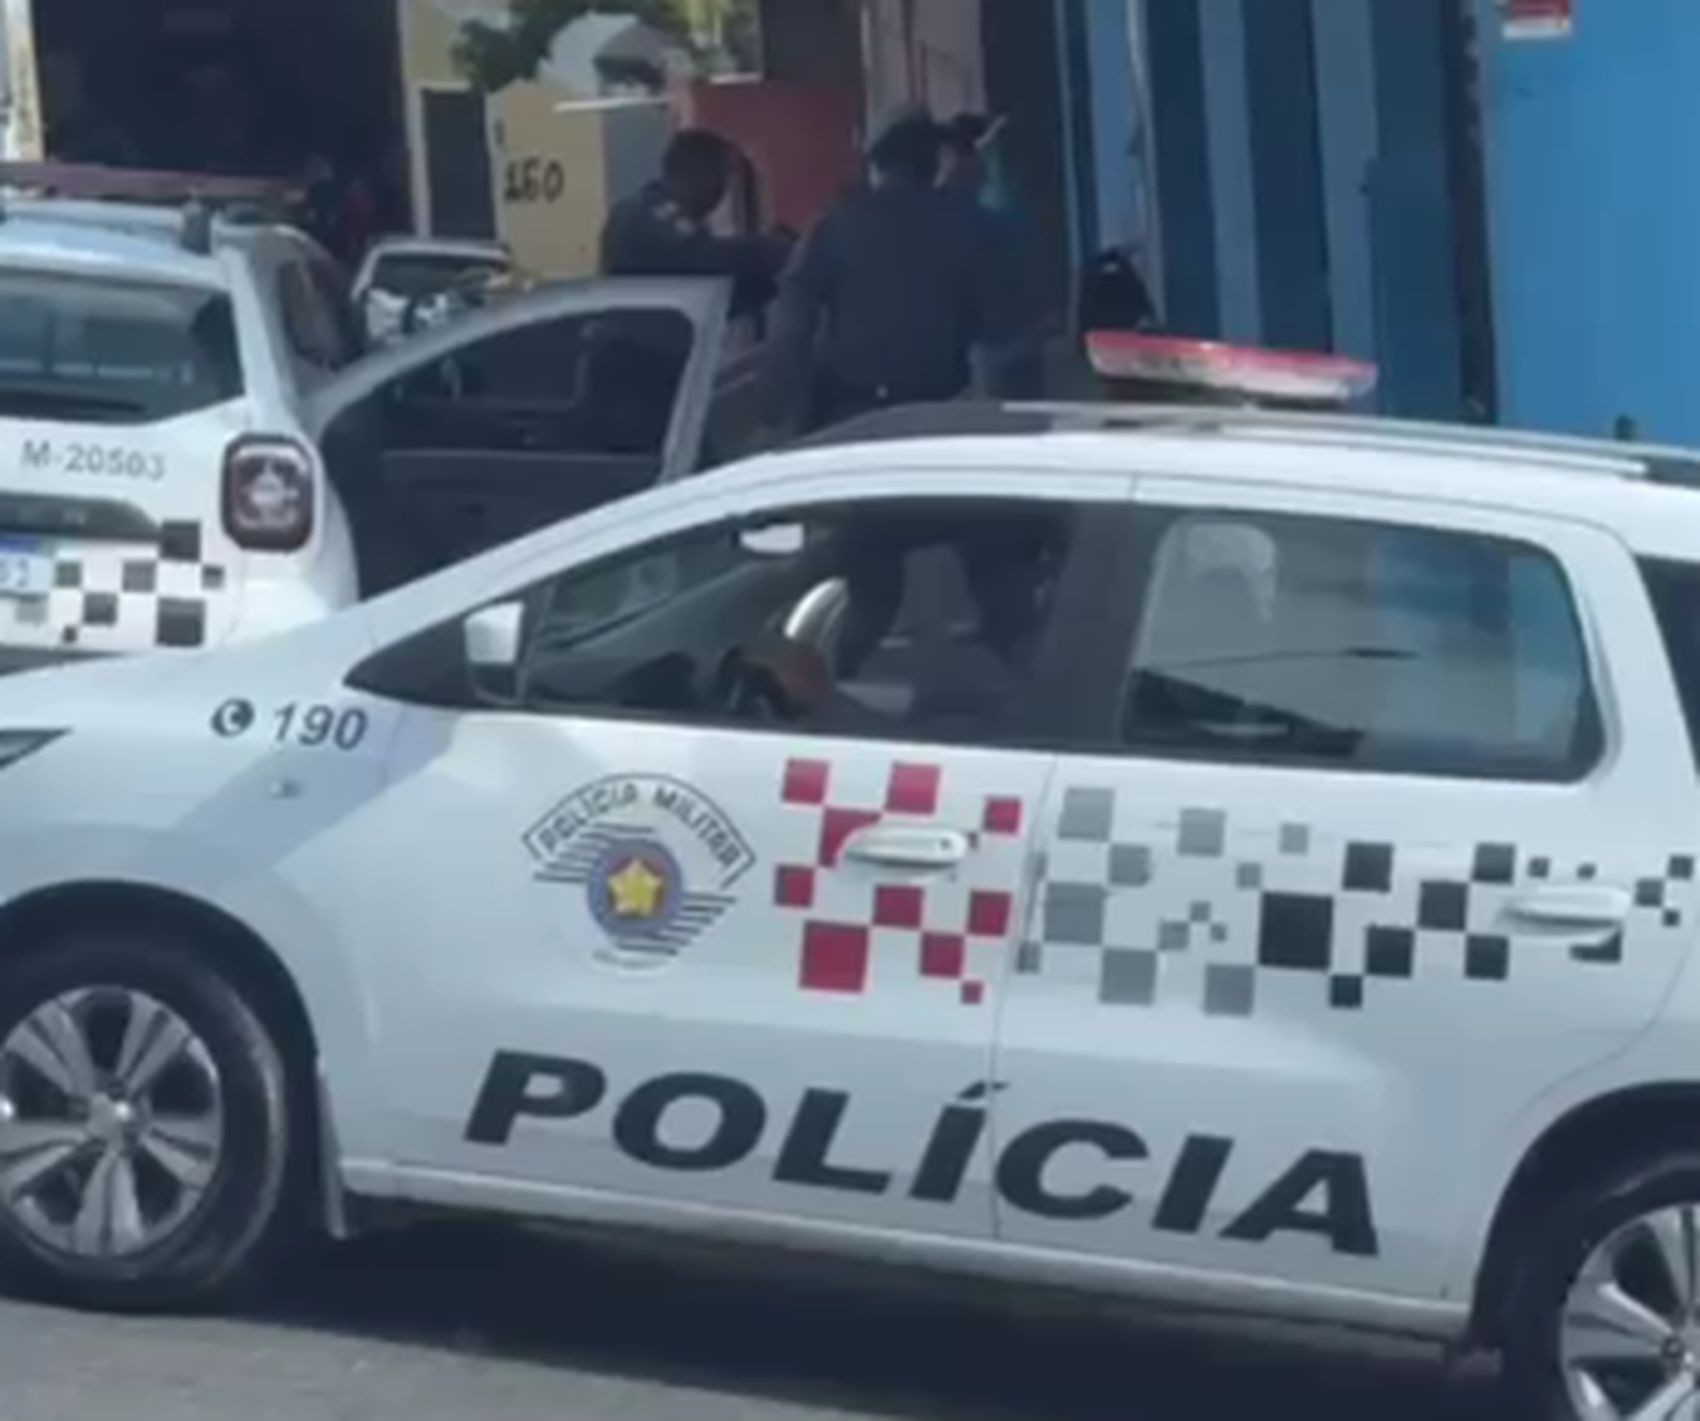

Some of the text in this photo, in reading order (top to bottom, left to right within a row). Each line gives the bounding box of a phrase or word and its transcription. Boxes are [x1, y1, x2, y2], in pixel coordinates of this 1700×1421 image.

[273, 700, 368, 751] 190
[654, 785, 741, 868] MILITAR
[463, 1049, 1380, 1257] POLÍCIA
